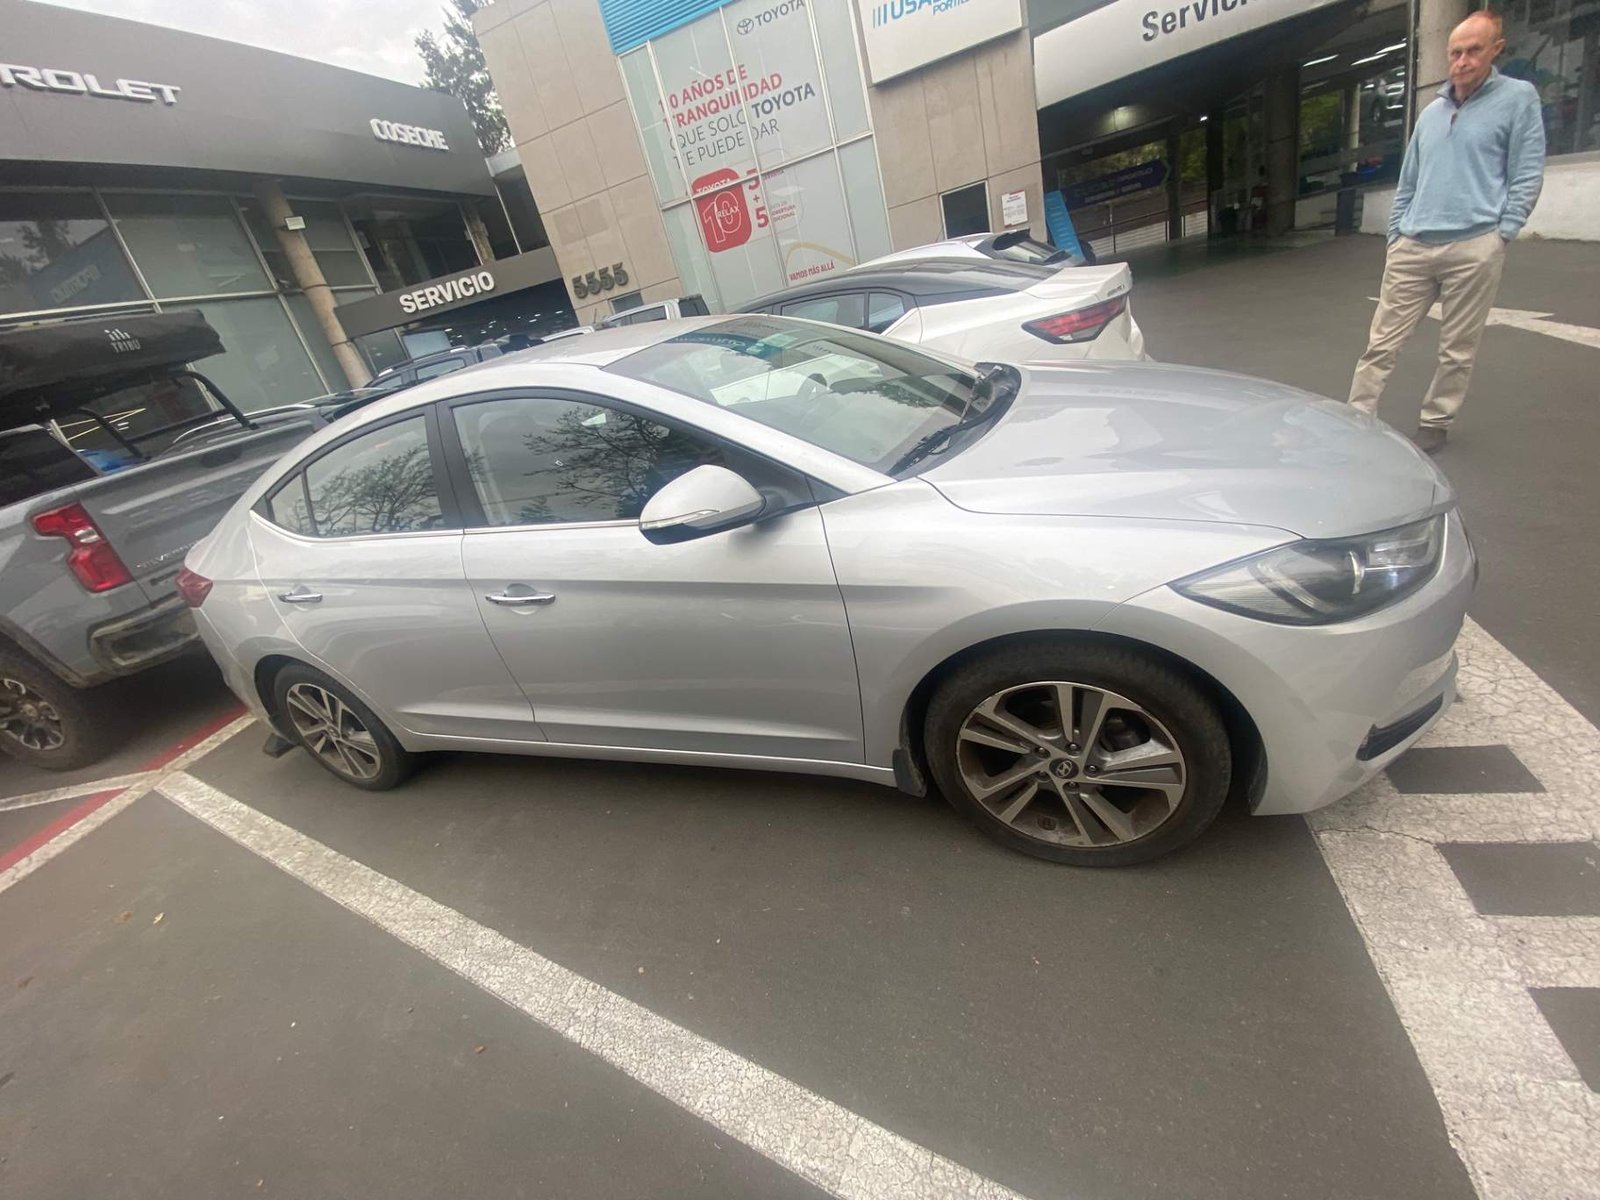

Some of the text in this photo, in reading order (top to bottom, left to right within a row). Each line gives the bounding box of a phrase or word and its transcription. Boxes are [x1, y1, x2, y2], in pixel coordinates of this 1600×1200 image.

[755, 0, 805, 27] TOYOTA
[891, 0, 944, 20] USA
[1142, 0, 1247, 42] Servic
[658, 64, 748, 113] 10 AÑOS DE
[669, 129, 706, 151] QUE
[751, 82, 816, 119] TOYOTA
[370, 118, 450, 151] COSECHE
[673, 150, 696, 169] TE
[698, 131, 746, 162] PUEDE
[716, 205, 741, 220] RELAX
[756, 206, 769, 228] 5
[571, 261, 629, 300] 5555
[789, 270, 808, 280] VAMOS
[808, 264, 820, 276] MÁS
[399, 271, 496, 314] SERVICIO
